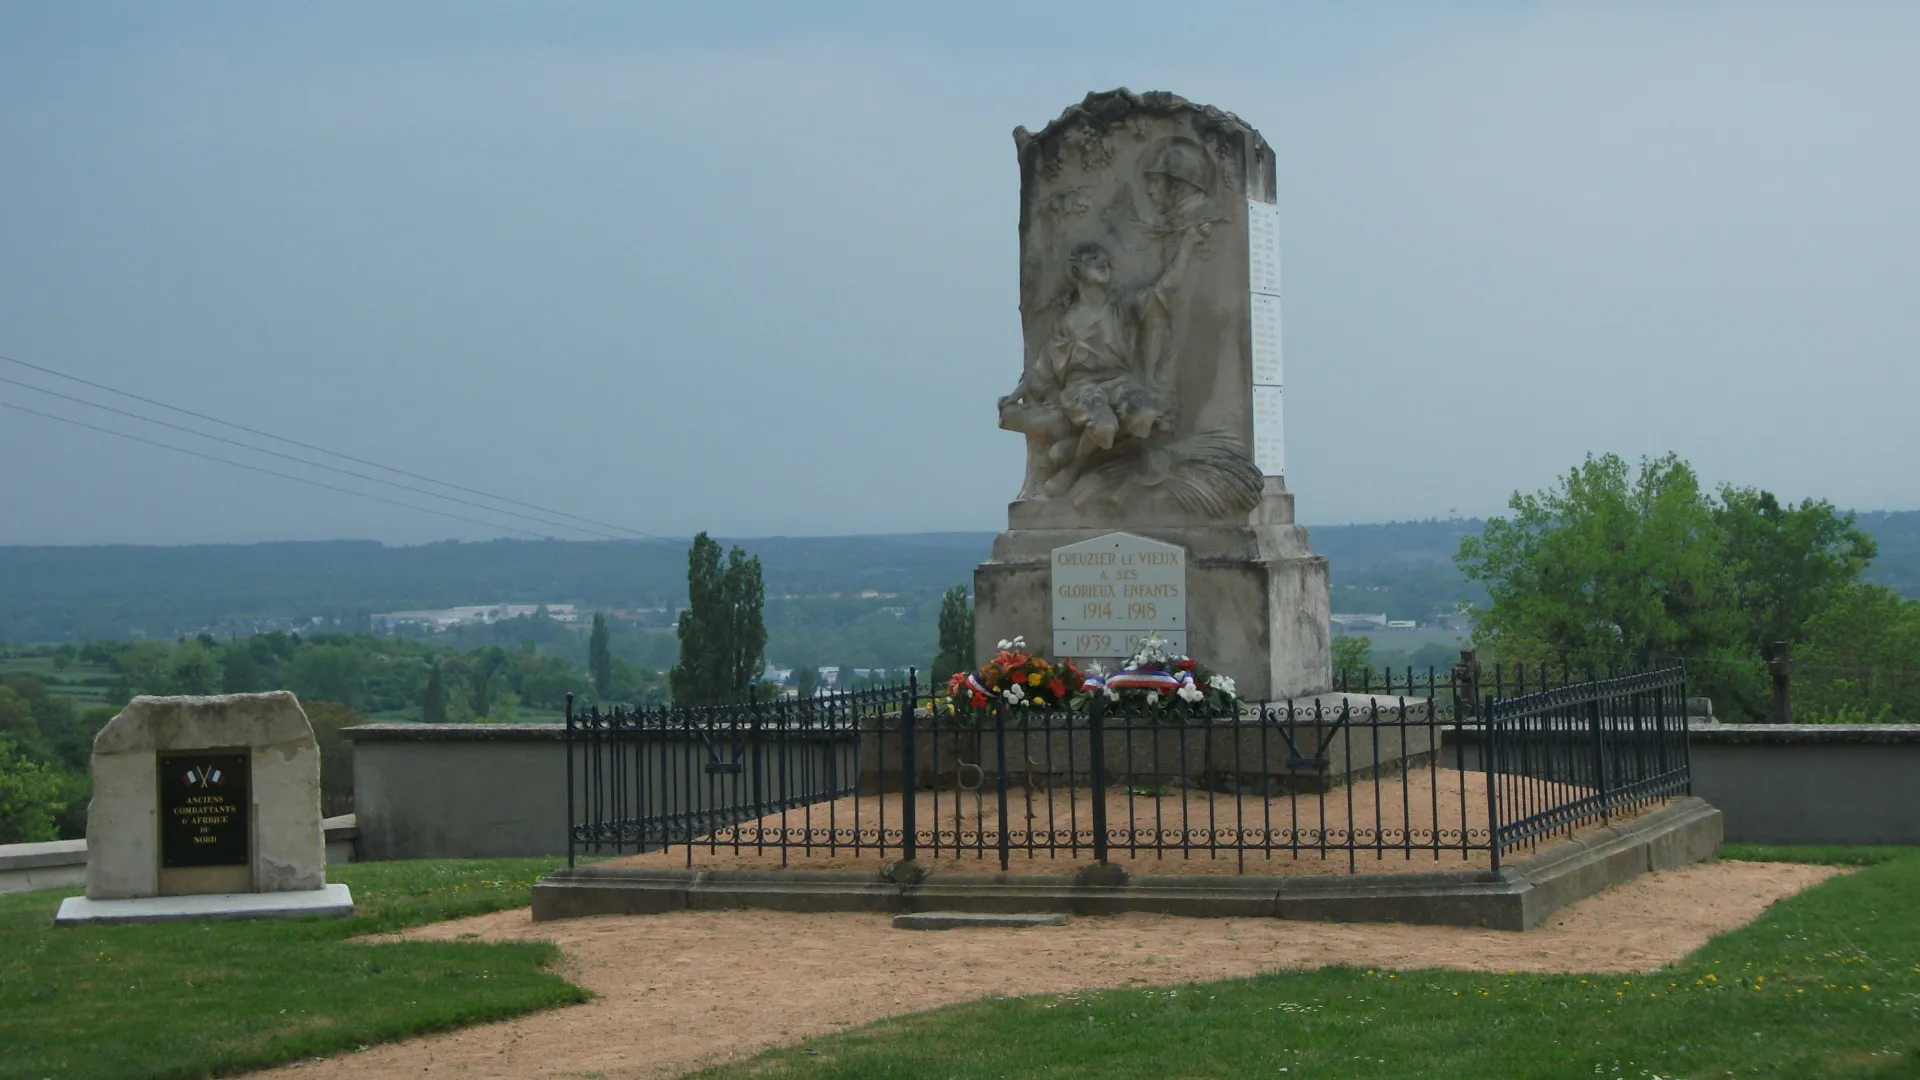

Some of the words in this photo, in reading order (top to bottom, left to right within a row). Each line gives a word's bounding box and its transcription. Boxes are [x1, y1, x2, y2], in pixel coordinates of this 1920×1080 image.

[1058, 552, 1116, 566] CREUZIER
[1121, 555, 1136, 566] LE
[1138, 552, 1178, 565] VIEUX
[1100, 571, 1108, 580] A
[1116, 569, 1138, 581] SES
[1058, 584, 1116, 598] GLORIEUX
[1124, 584, 1179, 598] ENFANTS
[1082, 602, 1113, 620] 1914
[1127, 602, 1157, 620] 1918
[1076, 634, 1111, 652] 1939
[186, 796, 224, 804] ANCIENS
[173, 805, 236, 814] COMBATTANTS
[192, 816, 228, 824] AFRIQUE
[193, 836, 217, 844] NORD
